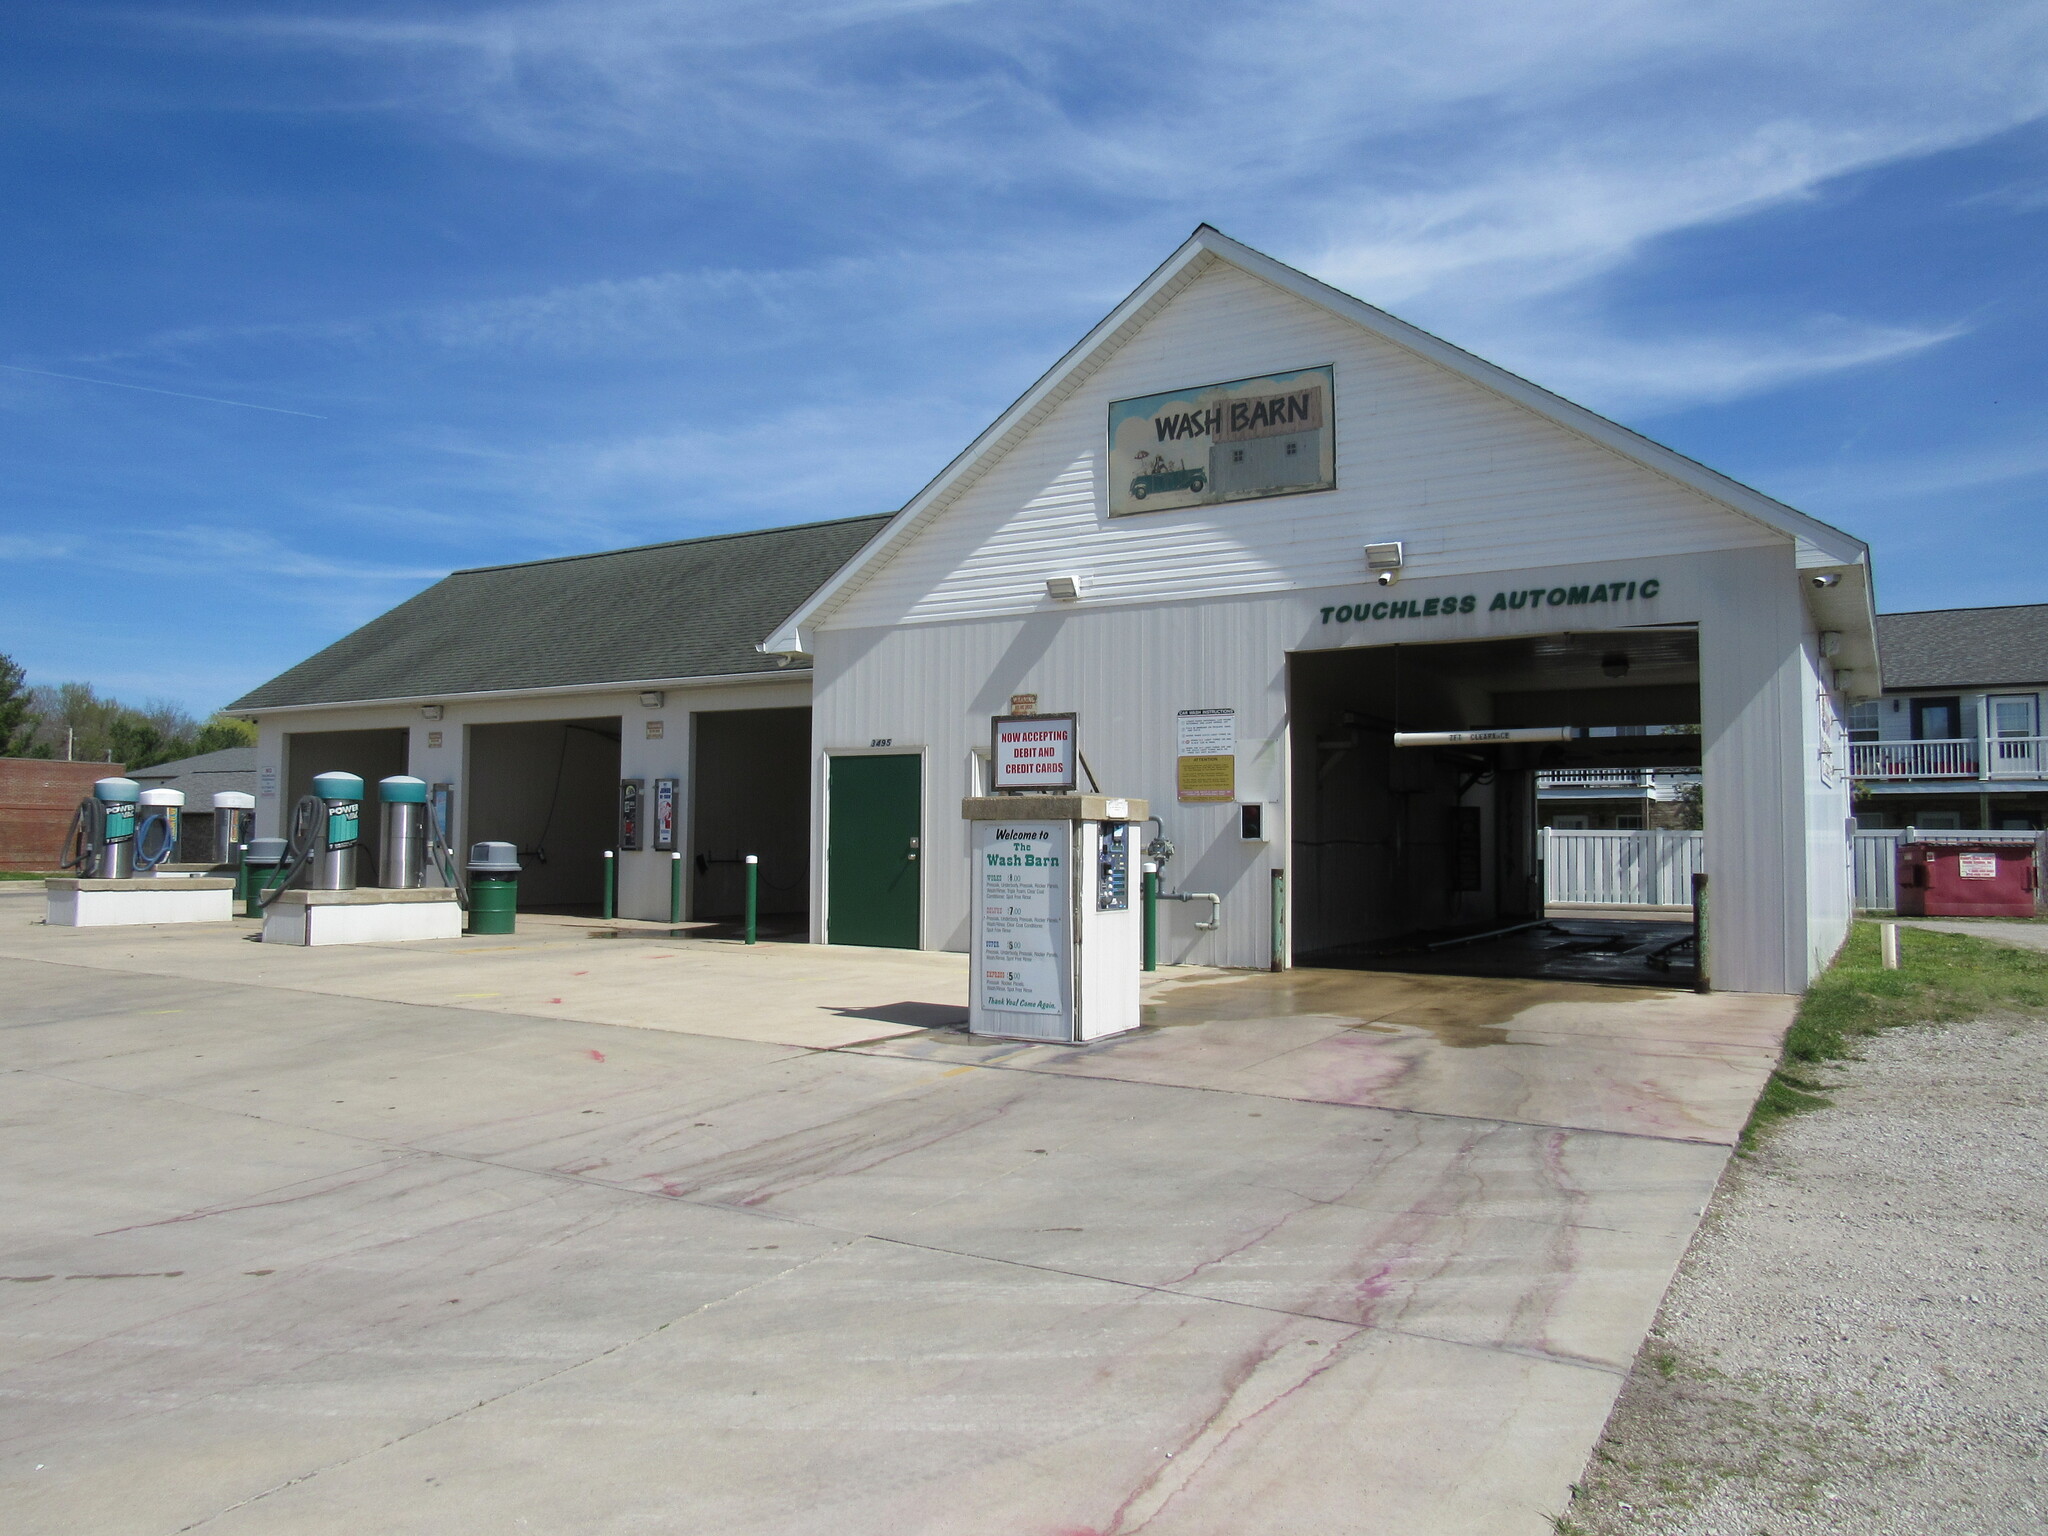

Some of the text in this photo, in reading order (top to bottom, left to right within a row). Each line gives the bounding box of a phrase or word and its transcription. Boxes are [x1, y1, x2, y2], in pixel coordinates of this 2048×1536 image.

[1155, 394, 1309, 442] WASH BARN
[1320, 579, 1660, 625] TOUCHLESS AUTOMATIC
[871, 738, 892, 747] 3495
[1001, 730, 1068, 743] NOW ACCEPTING
[1013, 747, 1055, 758] DEBIT AND
[1005, 763, 1064, 774] CREDIT CARDS
[996, 829, 1049, 840] Welcome to
[1013, 842, 1031, 851] The
[987, 854, 1059, 867] Wash Barn
[988, 996, 1056, 1010] Thank You! Come Again.
